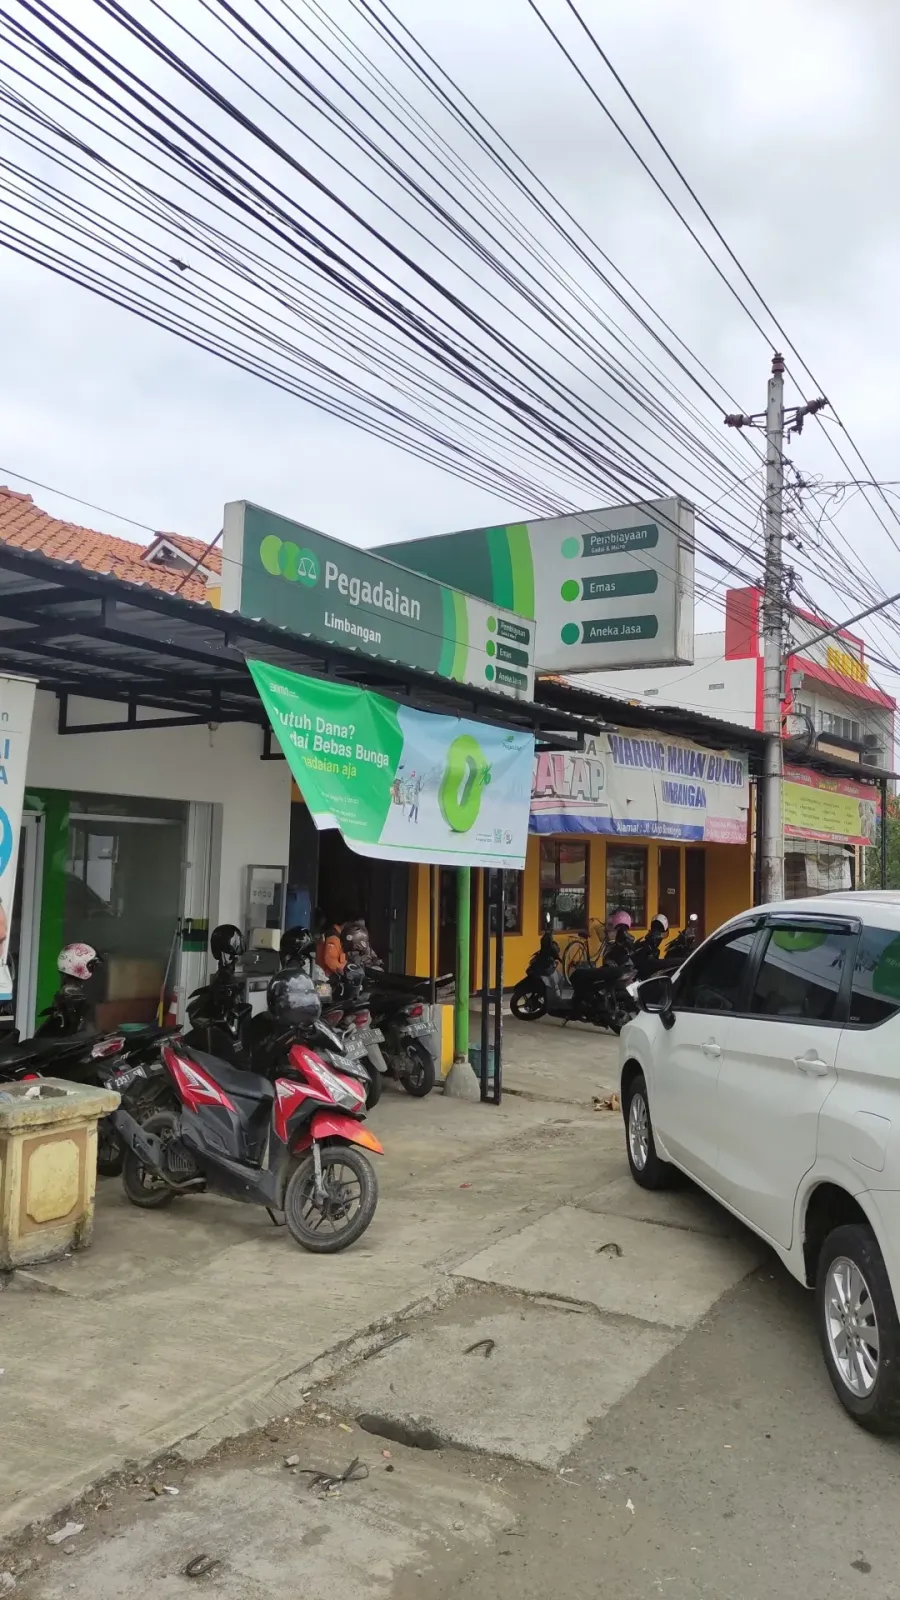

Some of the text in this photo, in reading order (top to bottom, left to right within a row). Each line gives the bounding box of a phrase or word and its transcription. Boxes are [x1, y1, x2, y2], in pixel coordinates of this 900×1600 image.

[590, 530, 648, 545] Pembiayaan
[325, 560, 421, 621] Pegadaian
[589, 582, 616, 593] Emas
[324, 611, 382, 644] Limbangan
[589, 624, 642, 638] Aneka Jasa
[273, 706, 355, 740] utuh Dana?
[313, 735, 352, 758] Bebas
[355, 744, 389, 768] Bunga
[607, 734, 665, 772] WARUNG
[341, 762, 357, 779] aja
[530, 751, 605, 802] ALAP
[616, 821, 638, 833] Alamat
